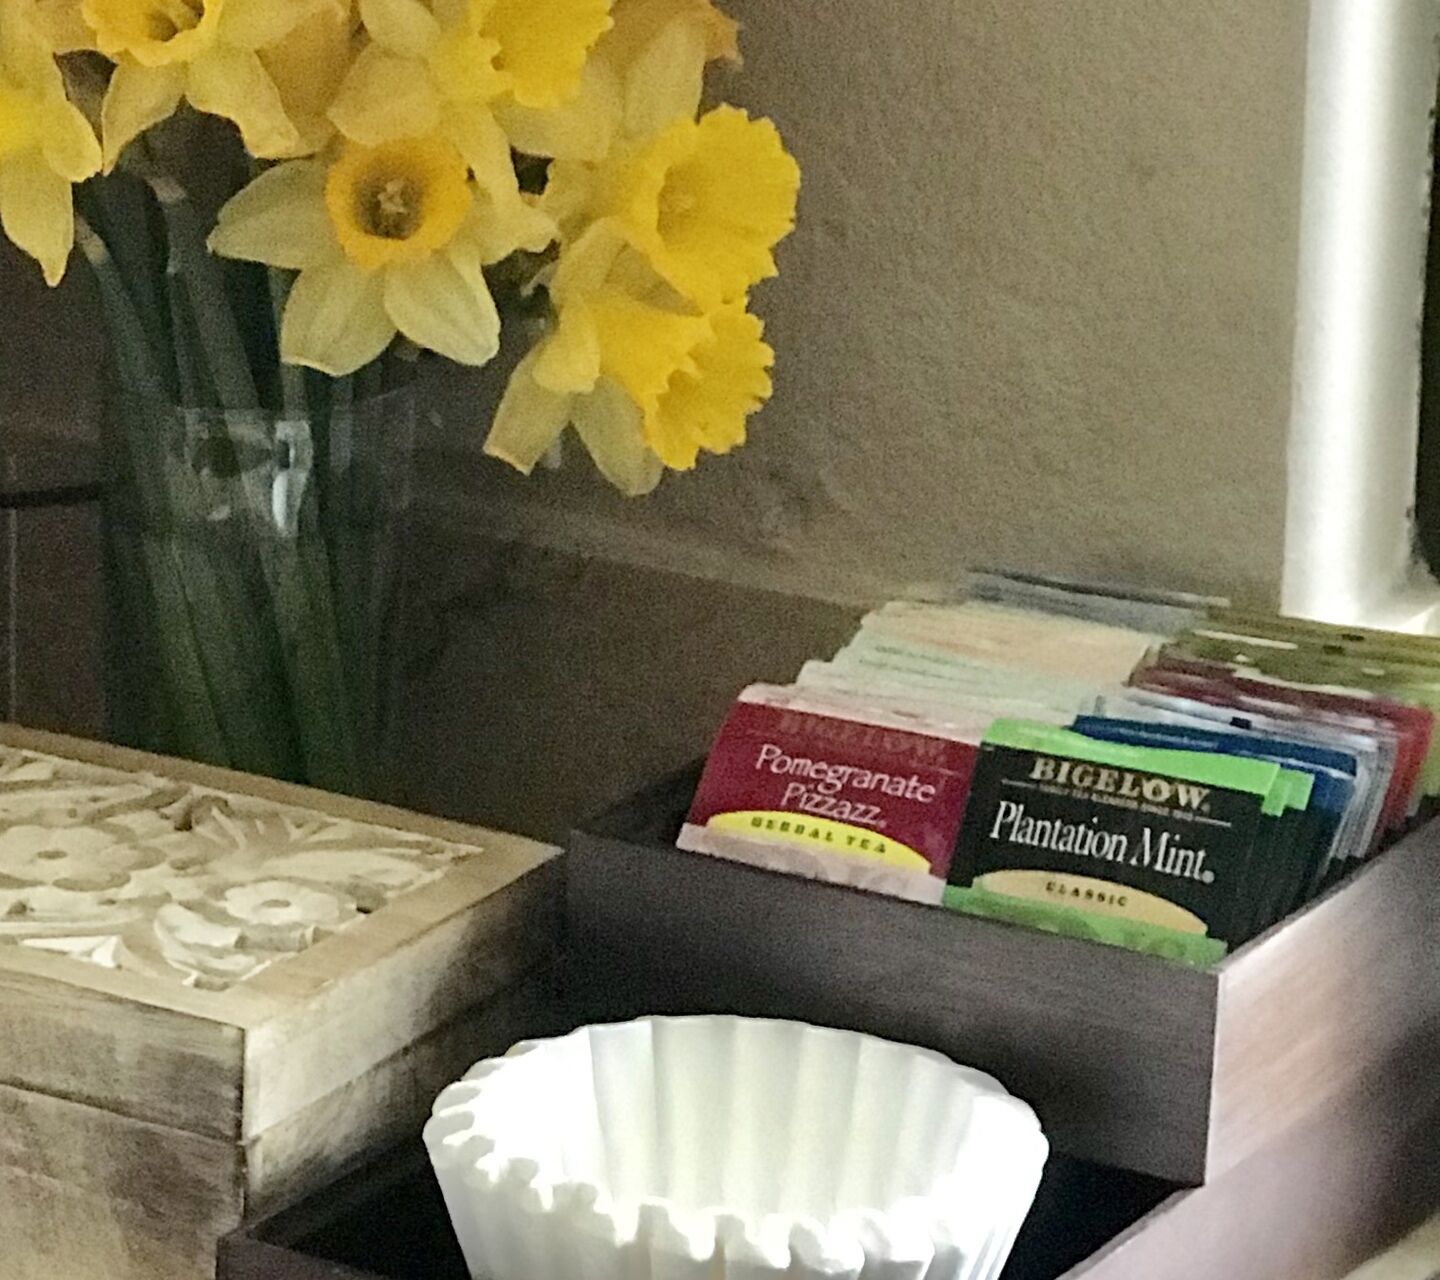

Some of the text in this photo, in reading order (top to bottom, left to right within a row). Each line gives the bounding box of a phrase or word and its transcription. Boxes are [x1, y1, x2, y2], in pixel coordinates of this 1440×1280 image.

[755, 743, 936, 803] Pomegranate
[1030, 756, 1210, 811] BIGELOW
[750, 816, 887, 854] HERBAL TEA
[989, 800, 1128, 863] Plantation
[1044, 880, 1129, 908] CLASSIC
